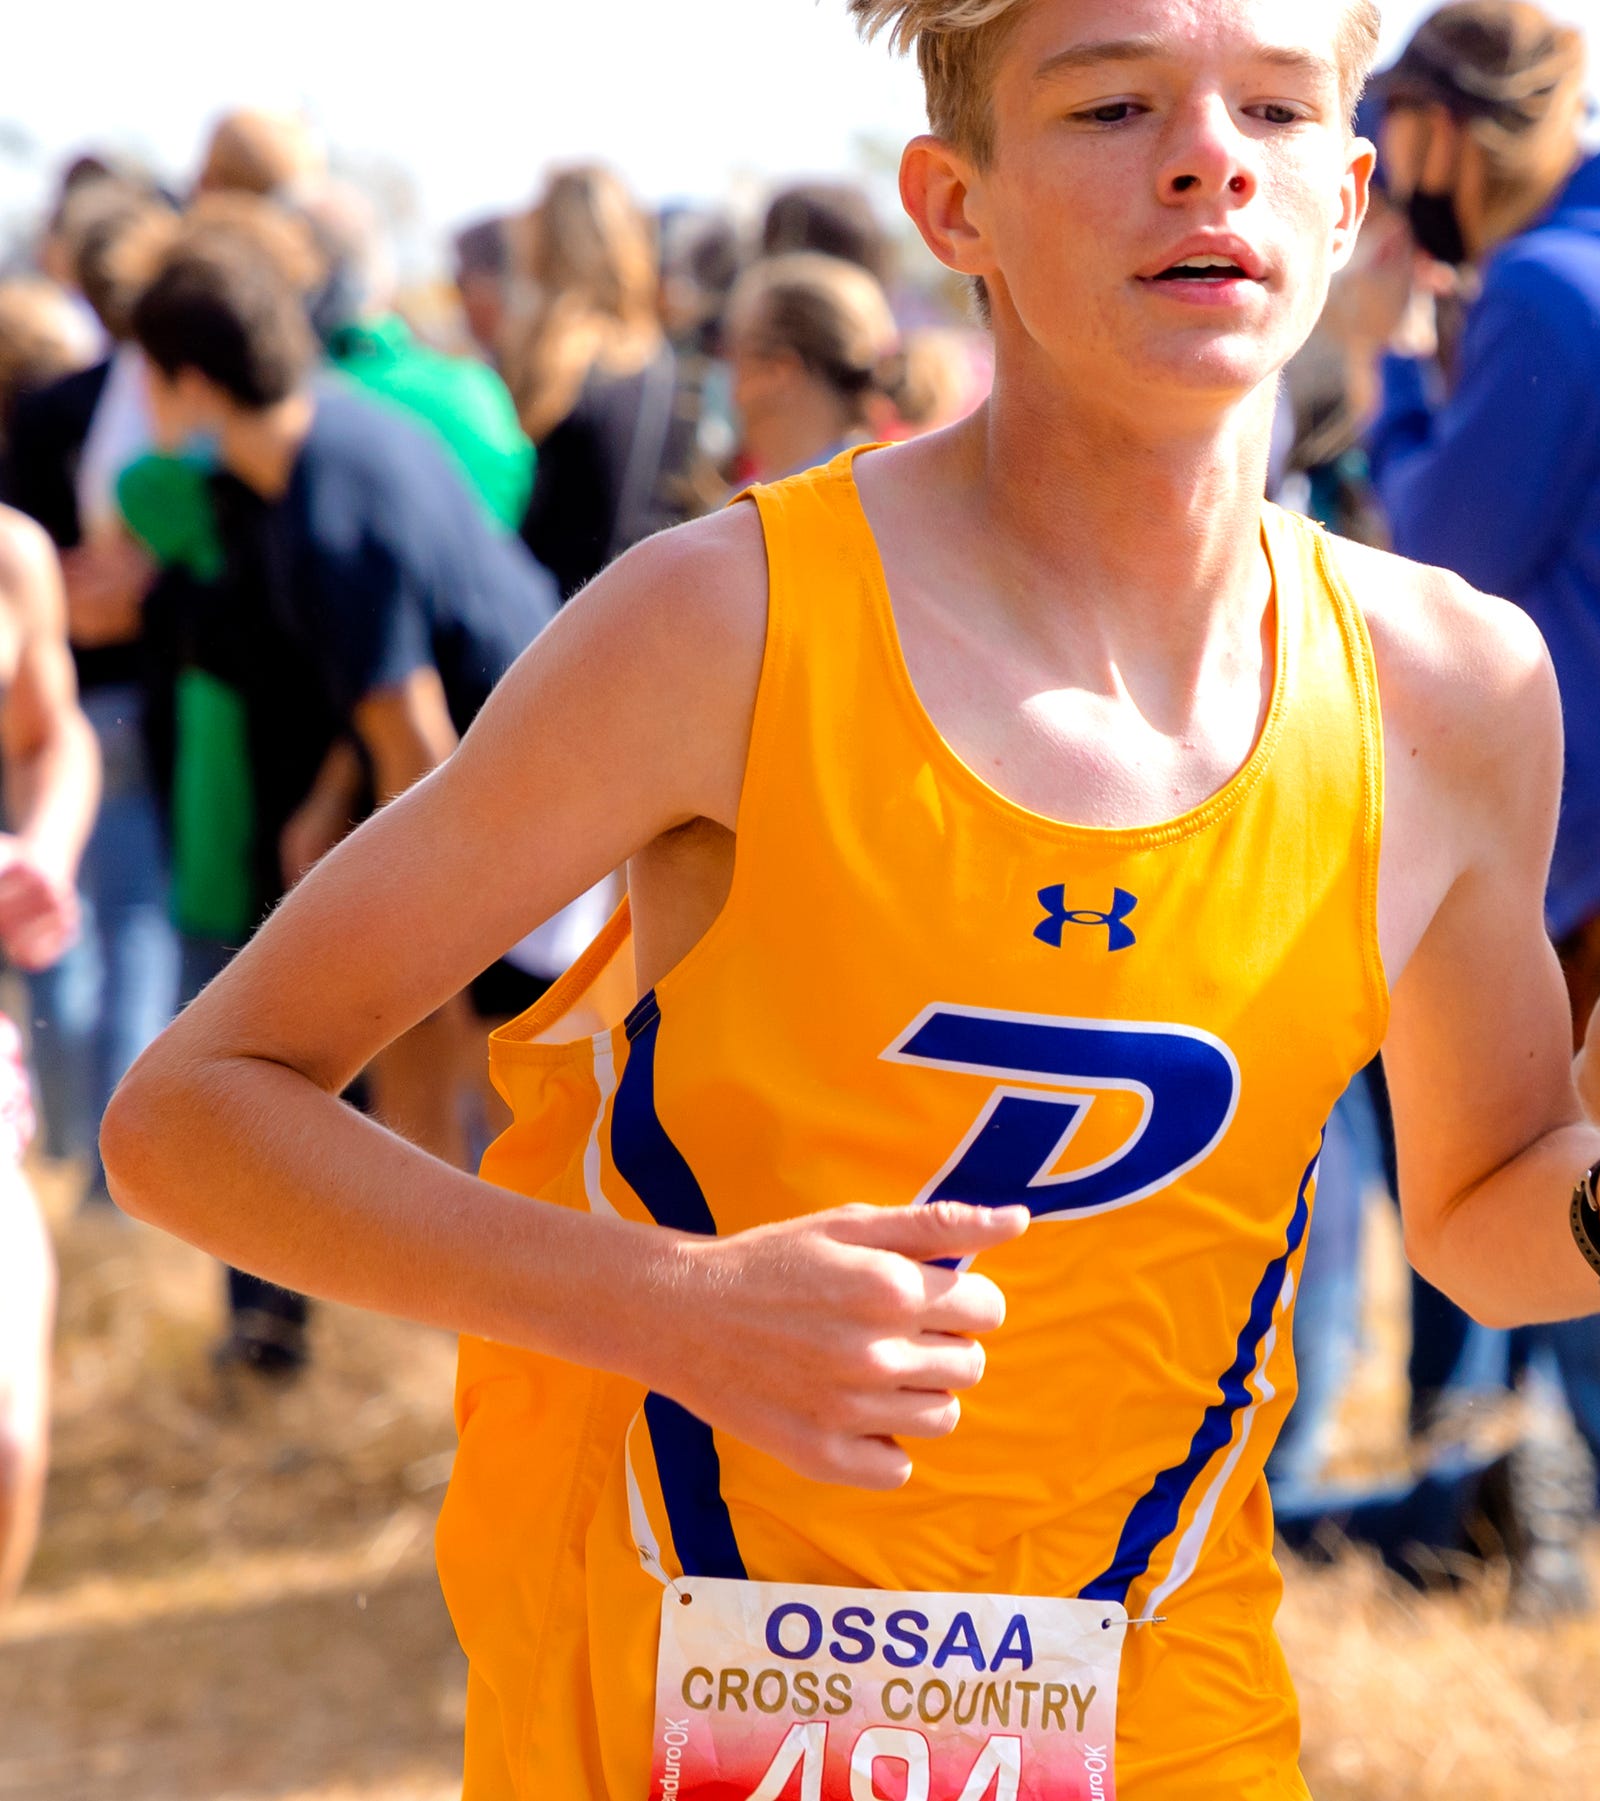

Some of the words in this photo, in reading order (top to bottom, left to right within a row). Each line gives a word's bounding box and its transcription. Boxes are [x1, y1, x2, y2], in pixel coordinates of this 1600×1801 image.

[764, 1602, 1034, 1672] OSSAA
[681, 1667, 853, 1715] CROSS
[881, 1677, 1098, 1733] COUNTRY
